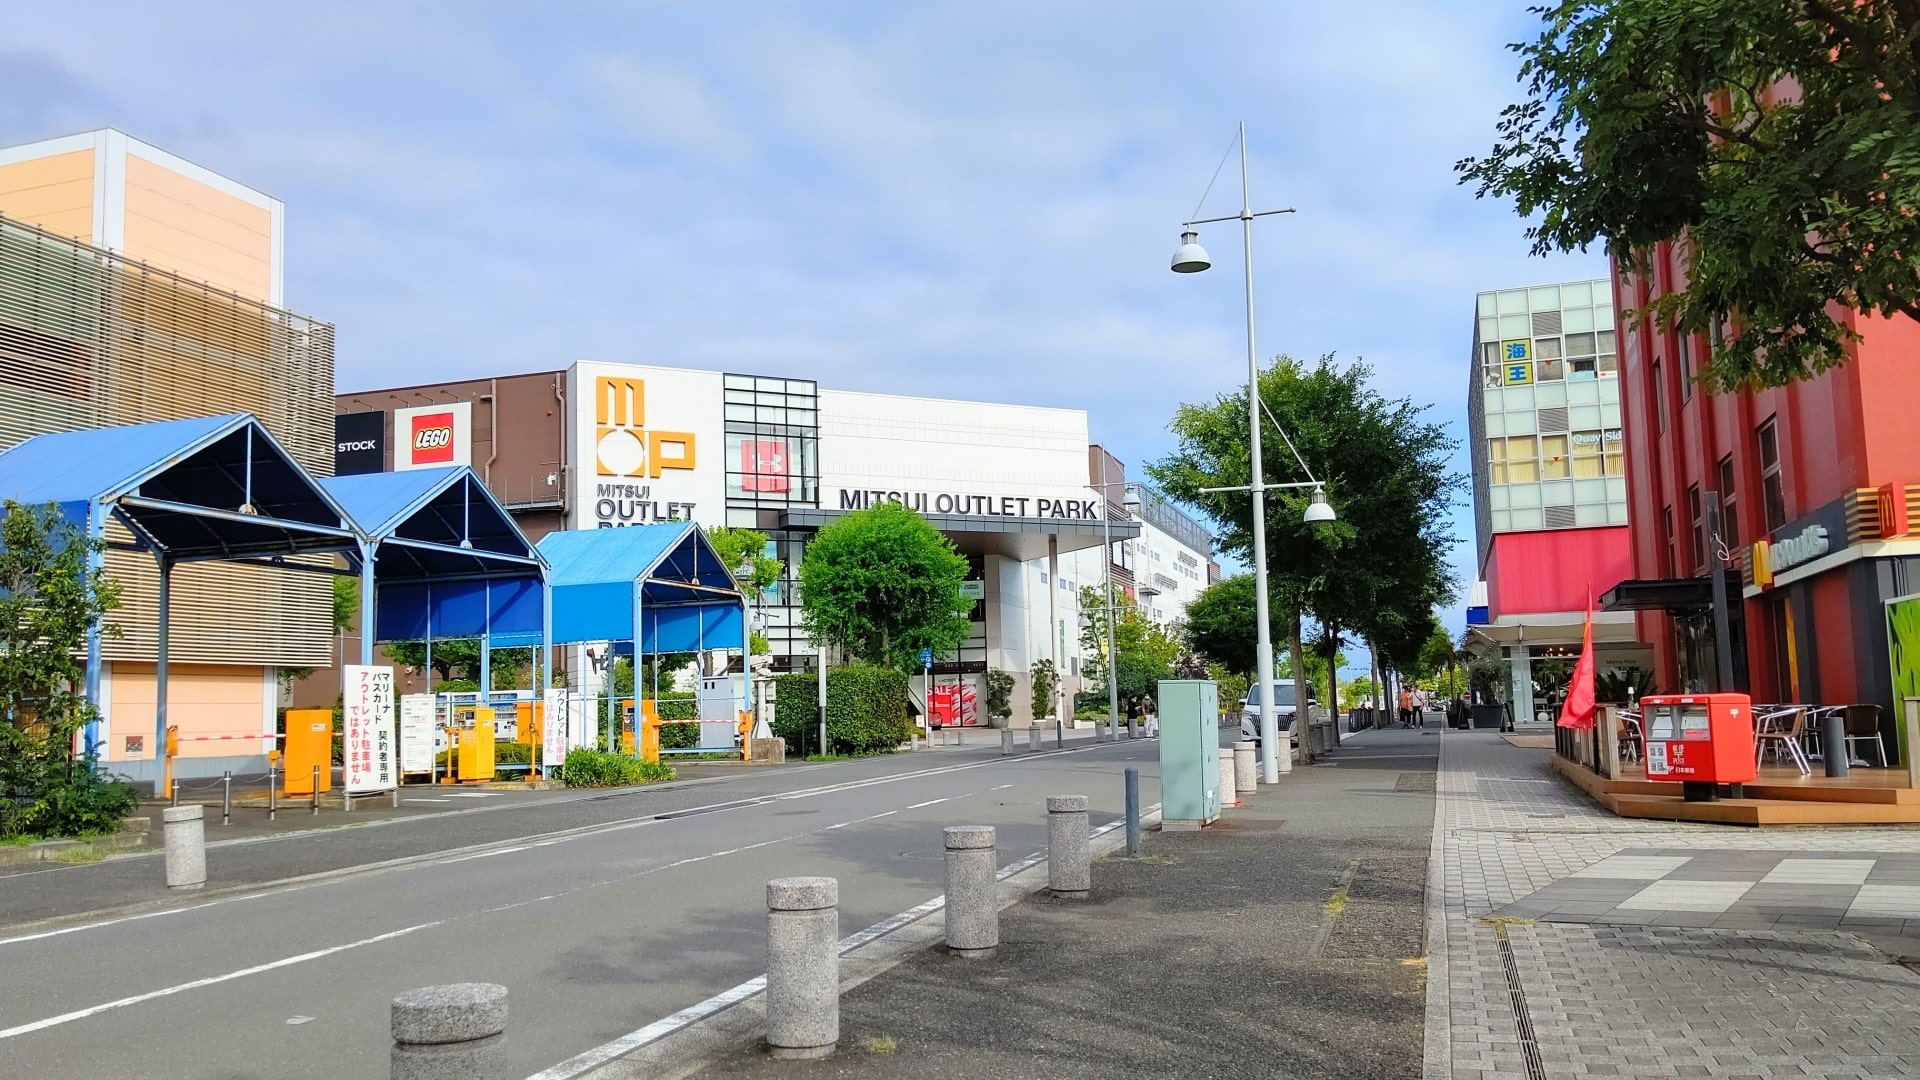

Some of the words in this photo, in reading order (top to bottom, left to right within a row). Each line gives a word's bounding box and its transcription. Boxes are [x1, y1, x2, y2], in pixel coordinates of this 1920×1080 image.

[1506, 343, 1526, 381] 海王
[338, 440, 375, 452] STOCK
[415, 427, 452, 449] LEGO
[1573, 434, 1602, 445] Quay
[597, 484, 650, 499] MITSUI
[840, 489, 928, 513] MITSUI
[935, 493, 1030, 517] OUTLET
[1036, 498, 1097, 520] PARK
[595, 499, 696, 521] OUTLET
[382, 672, 391, 714] マリーナ
[927, 686, 952, 695] SALE
[360, 671, 372, 773] アウトレット駐車場
[350, 705, 360, 785] ではありません
[378, 730, 389, 783] 契約者専用
